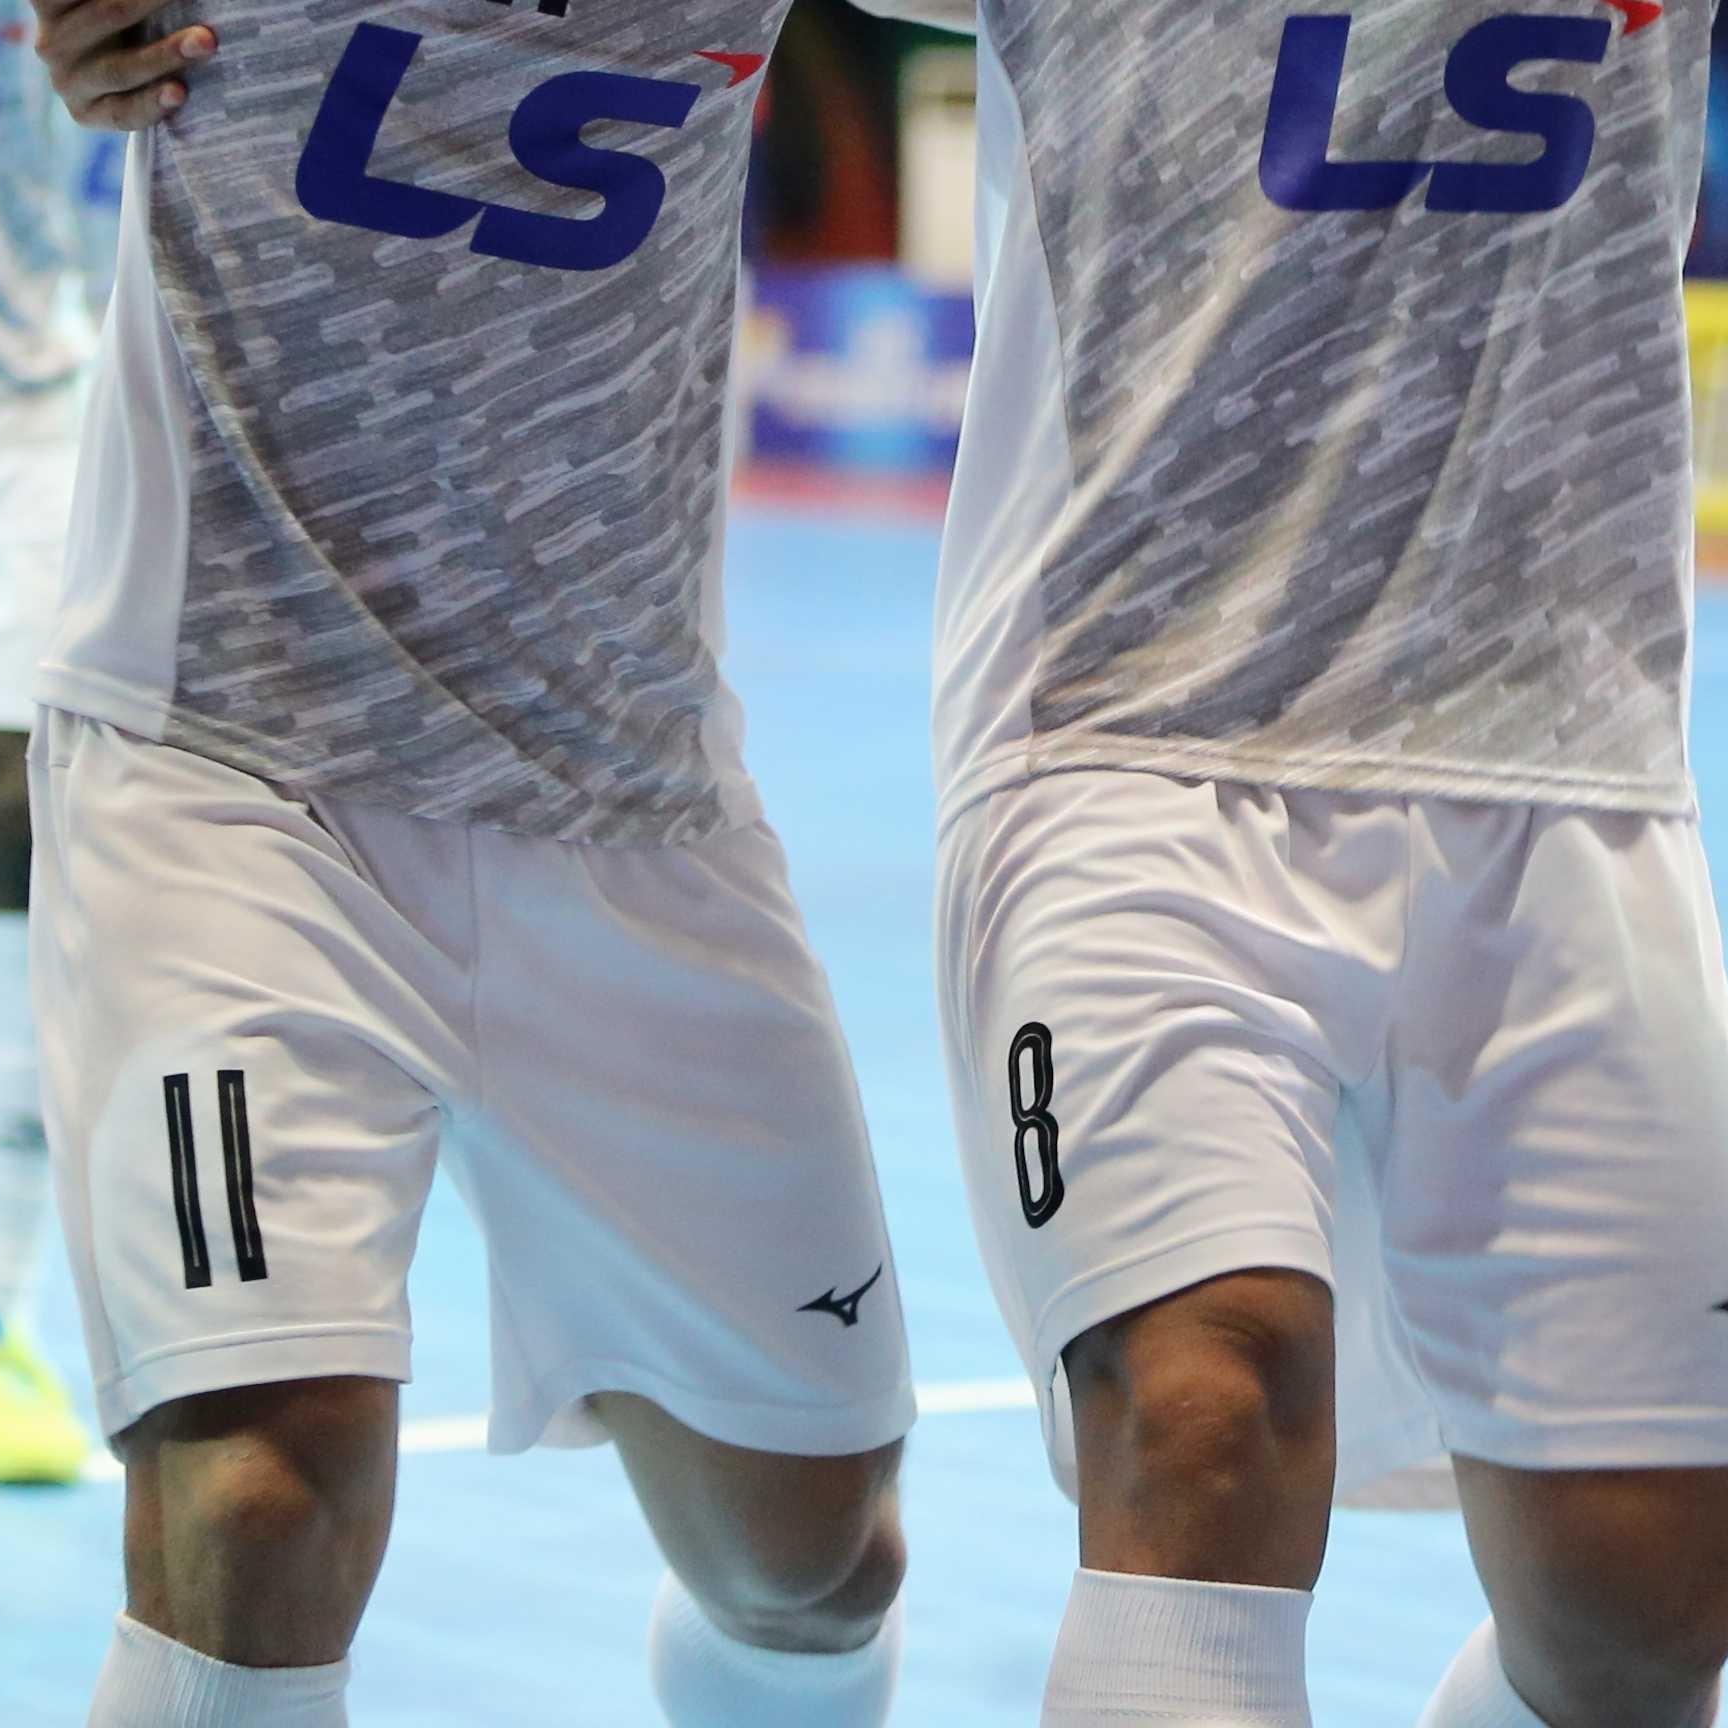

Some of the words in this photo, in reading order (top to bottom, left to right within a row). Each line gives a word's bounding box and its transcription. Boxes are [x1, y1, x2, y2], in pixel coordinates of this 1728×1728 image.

[294, 21, 702, 272] LS
[1258, 13, 1613, 213] LS
[162, 1069, 269, 1289] 11
[1007, 1020, 1066, 1230] 8
